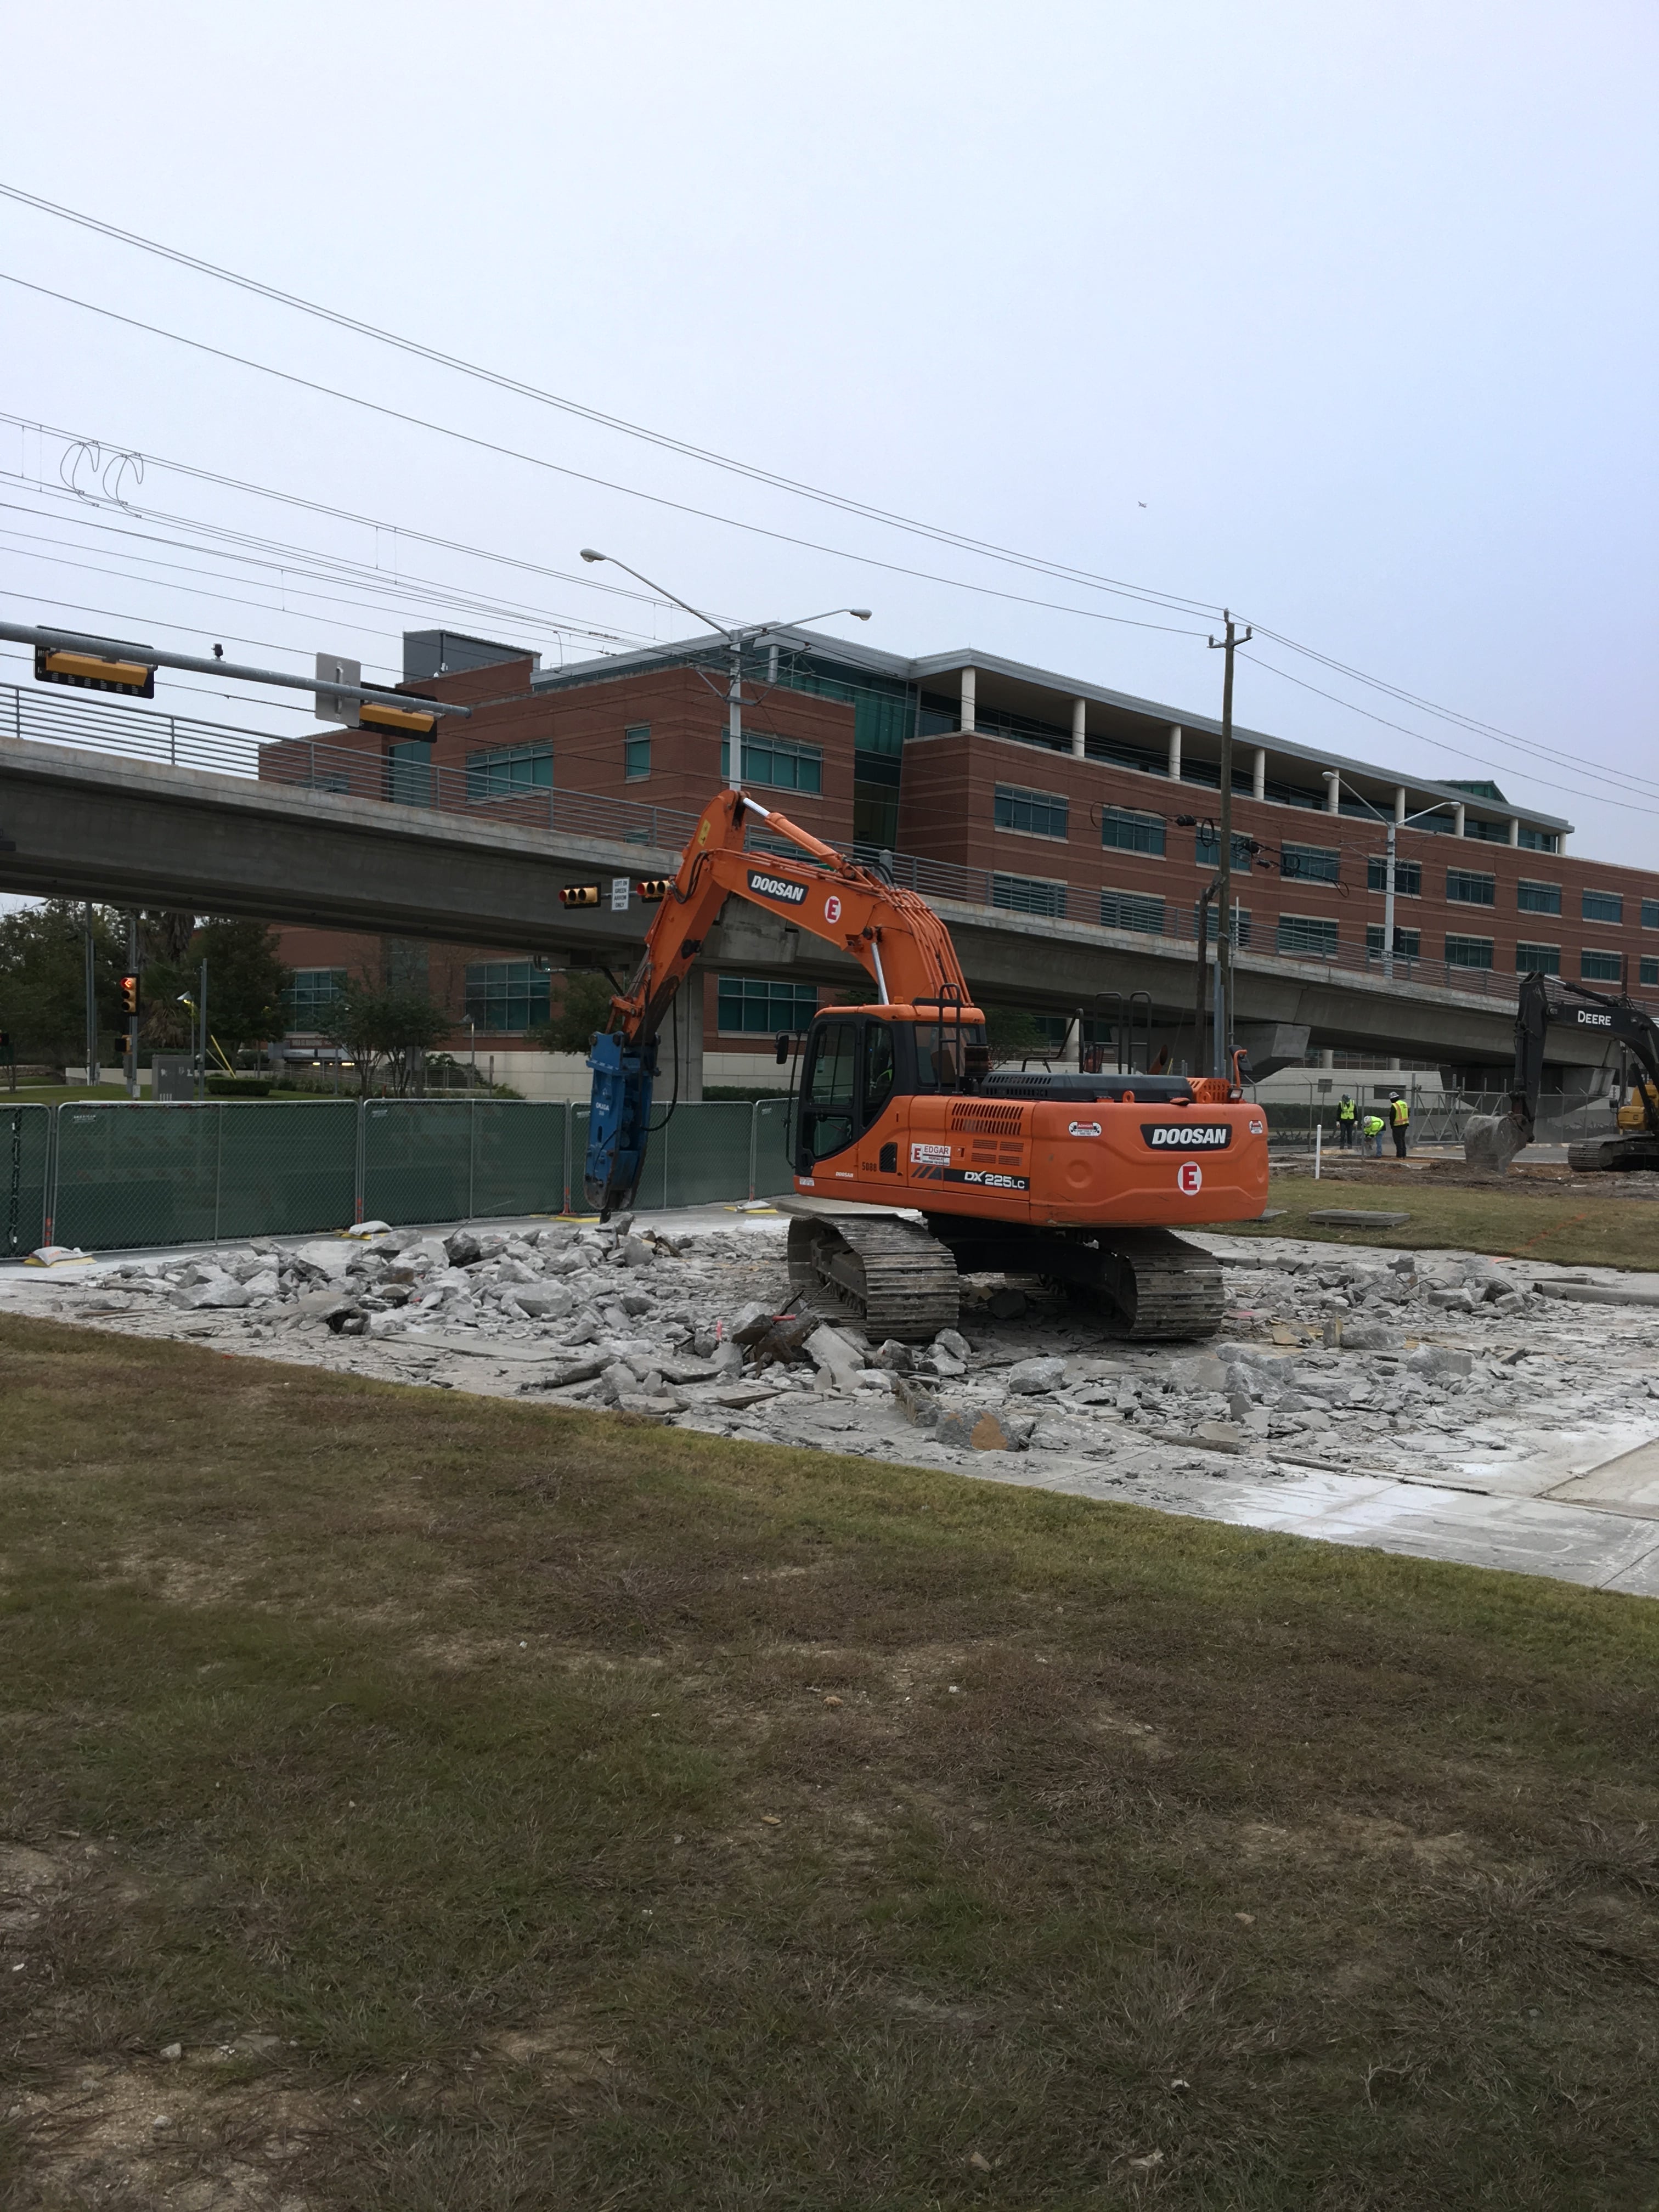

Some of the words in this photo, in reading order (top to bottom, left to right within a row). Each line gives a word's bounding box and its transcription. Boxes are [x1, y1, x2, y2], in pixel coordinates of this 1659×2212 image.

[751, 875, 804, 901] DOOSAN
[827, 899, 839, 921] E
[1577, 1010, 1612, 1026] DEERE
[1152, 1128, 1227, 1144] DOOSAN
[914, 1147, 921, 1160] E
[924, 1145, 949, 1155] EDGAR
[861, 1161, 877, 1172] 5088
[1183, 1165, 1198, 1191] E
